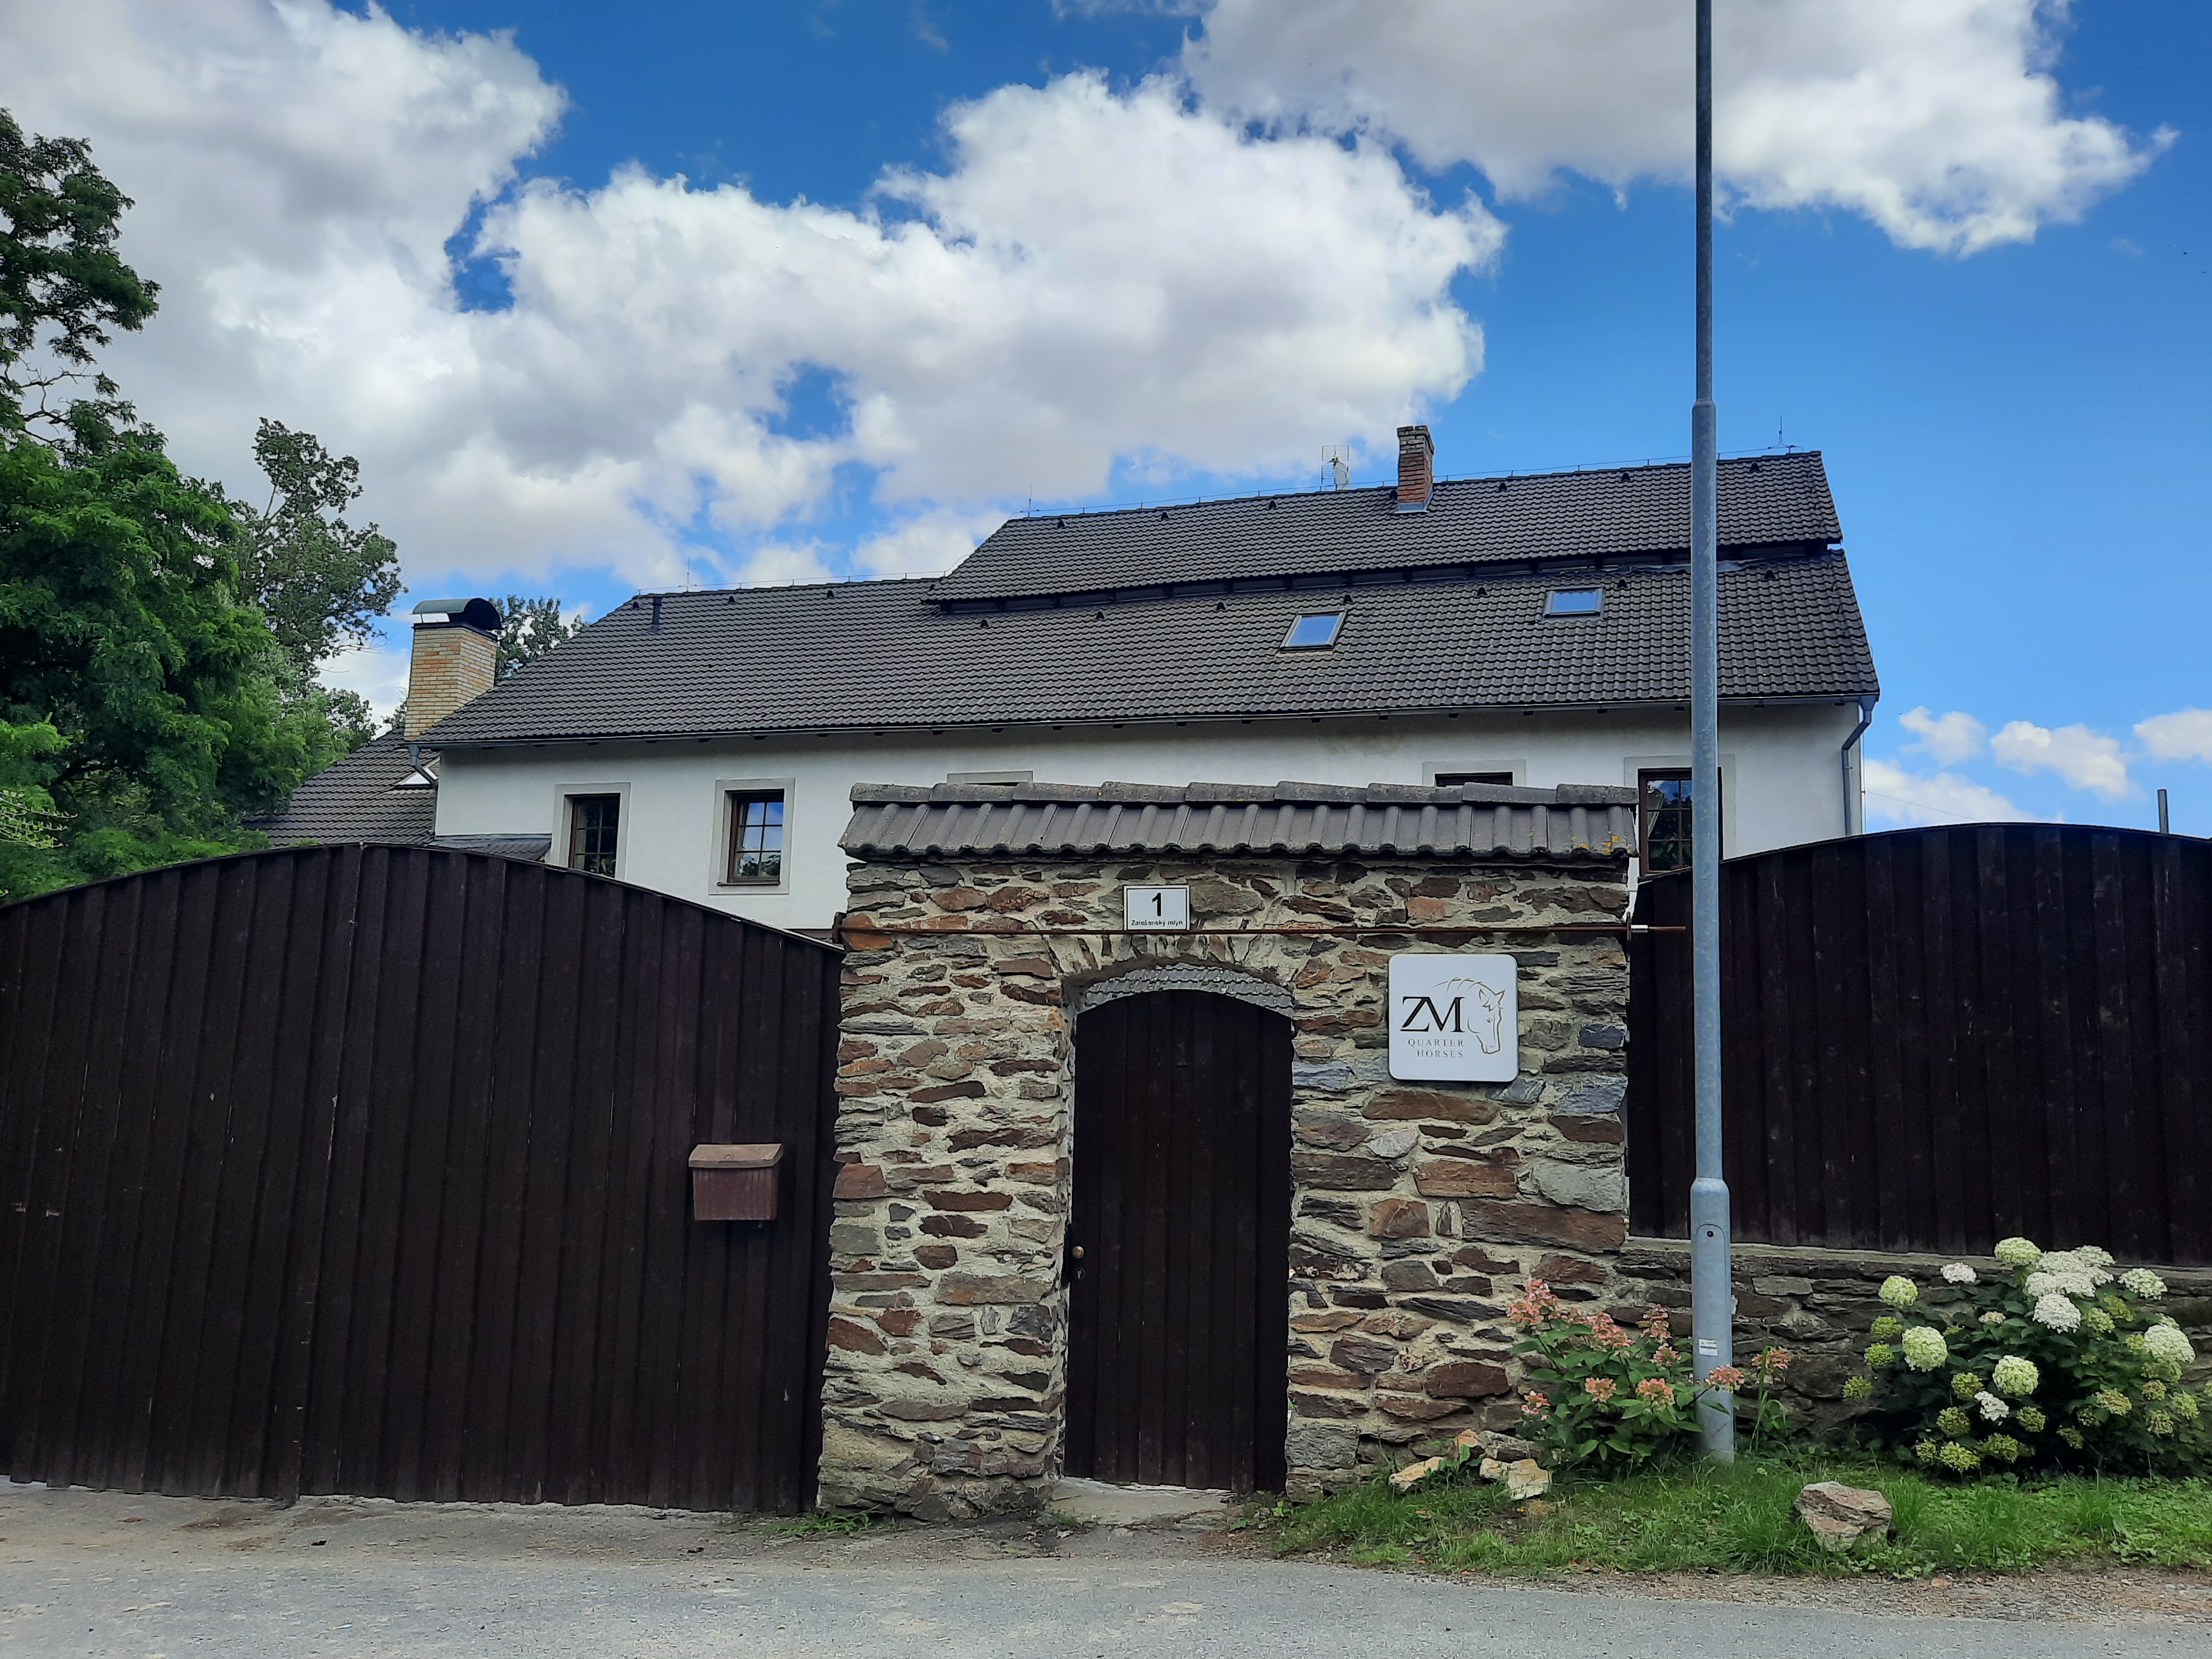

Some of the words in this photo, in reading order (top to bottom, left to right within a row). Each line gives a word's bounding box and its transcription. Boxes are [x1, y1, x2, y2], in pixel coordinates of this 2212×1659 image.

[1152, 893, 1161, 917] 1
[1400, 997, 1465, 1032] ZM
[1408, 1039, 1464, 1047] QUARTER
